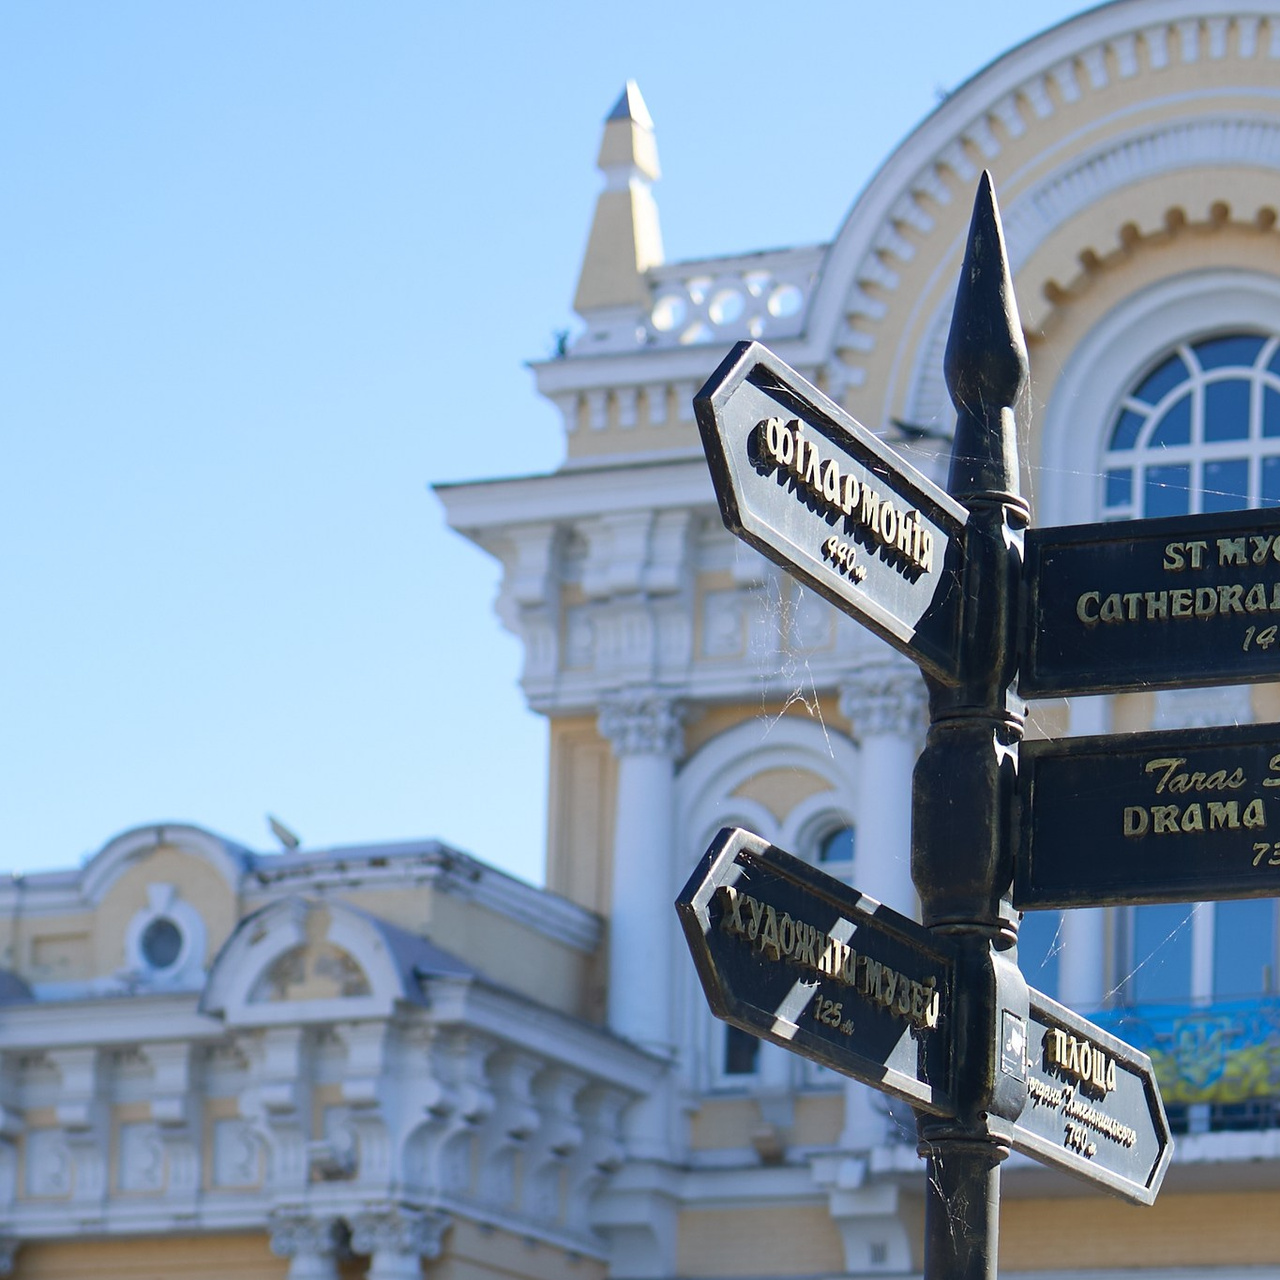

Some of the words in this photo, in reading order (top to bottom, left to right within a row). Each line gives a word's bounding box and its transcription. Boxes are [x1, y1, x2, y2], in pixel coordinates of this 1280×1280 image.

[827, 535, 857, 572] 440
[1163, 540, 1208, 571] ST
[1144, 757, 1247, 794] Taras
[1123, 798, 1267, 836] DRAMA
[814, 994, 842, 1028] 125
[1054, 1027, 1117, 1092] ПЛОЩА
